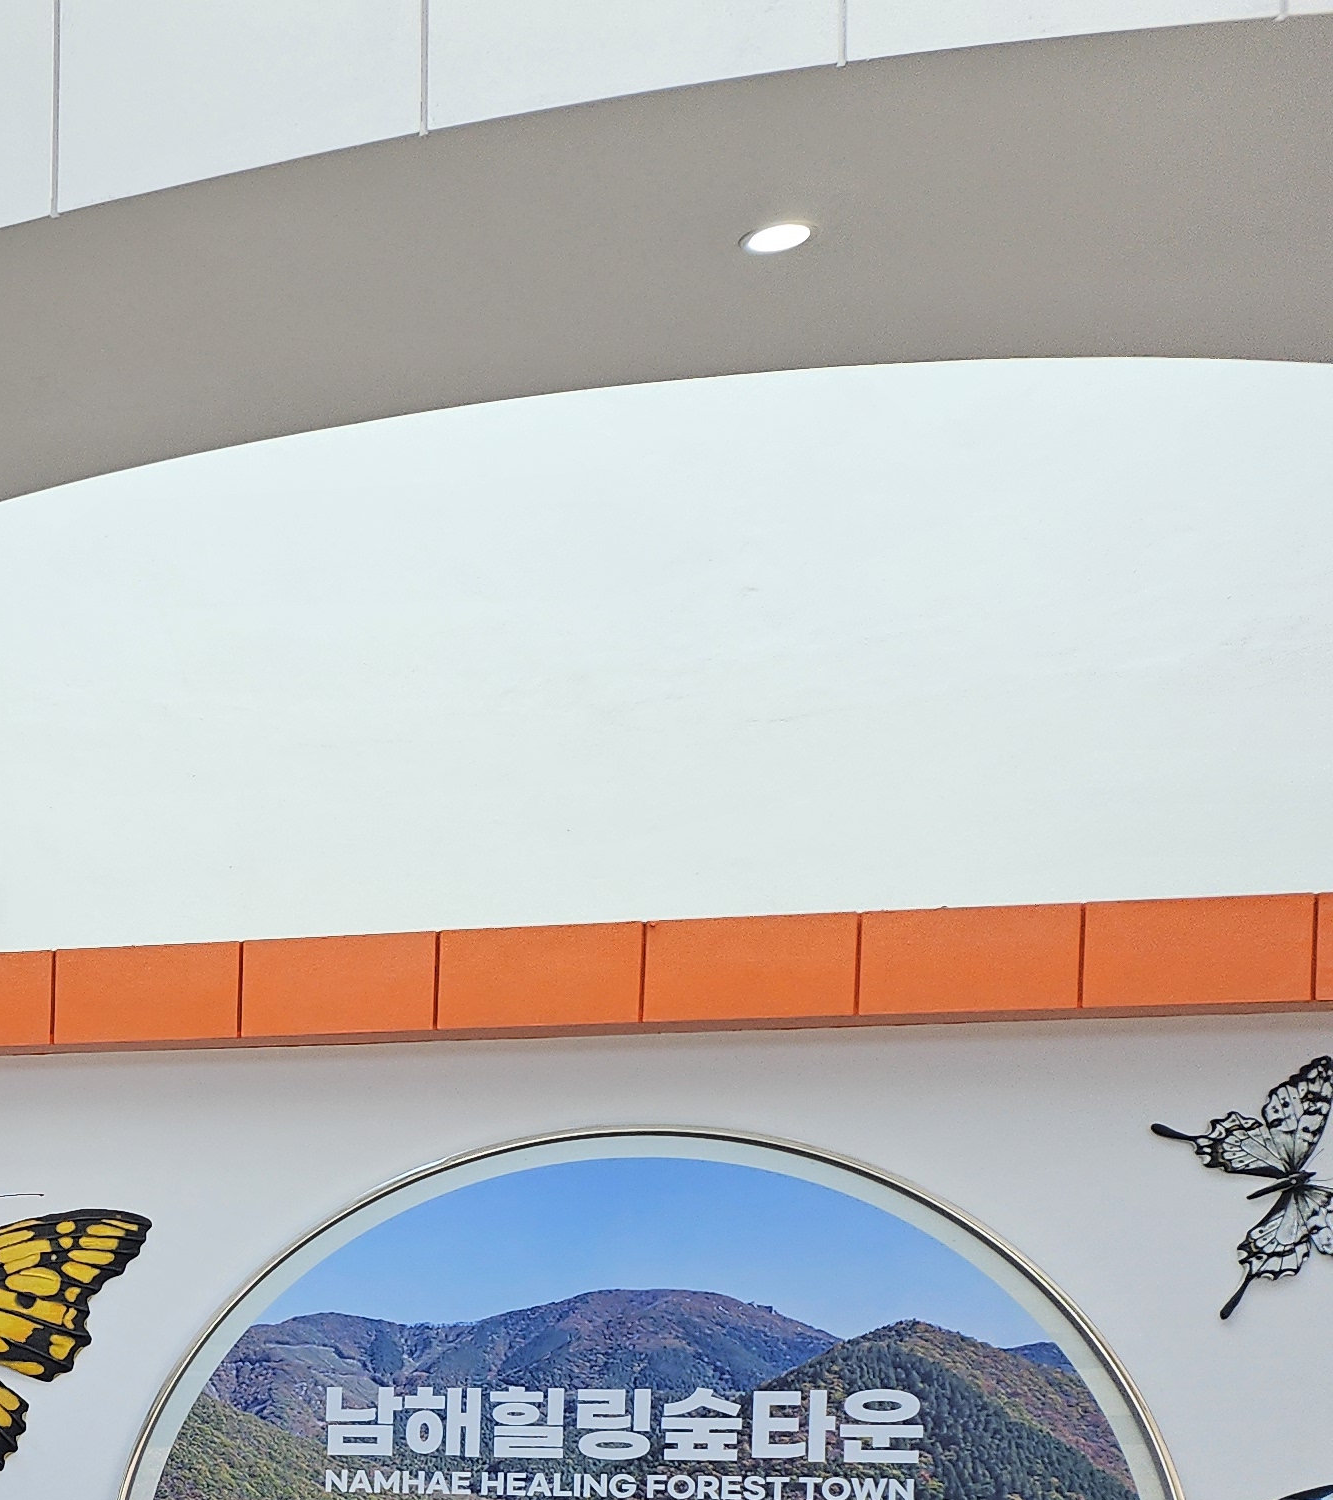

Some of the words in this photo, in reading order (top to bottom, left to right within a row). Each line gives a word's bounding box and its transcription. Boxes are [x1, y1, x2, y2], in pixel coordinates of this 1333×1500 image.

[325, 1386, 924, 1464] 남해힐링숲타운
[325, 1469, 472, 1495] NAMHAE
[481, 1471, 637, 1499] HEALING
[646, 1474, 790, 1500] FOREST
